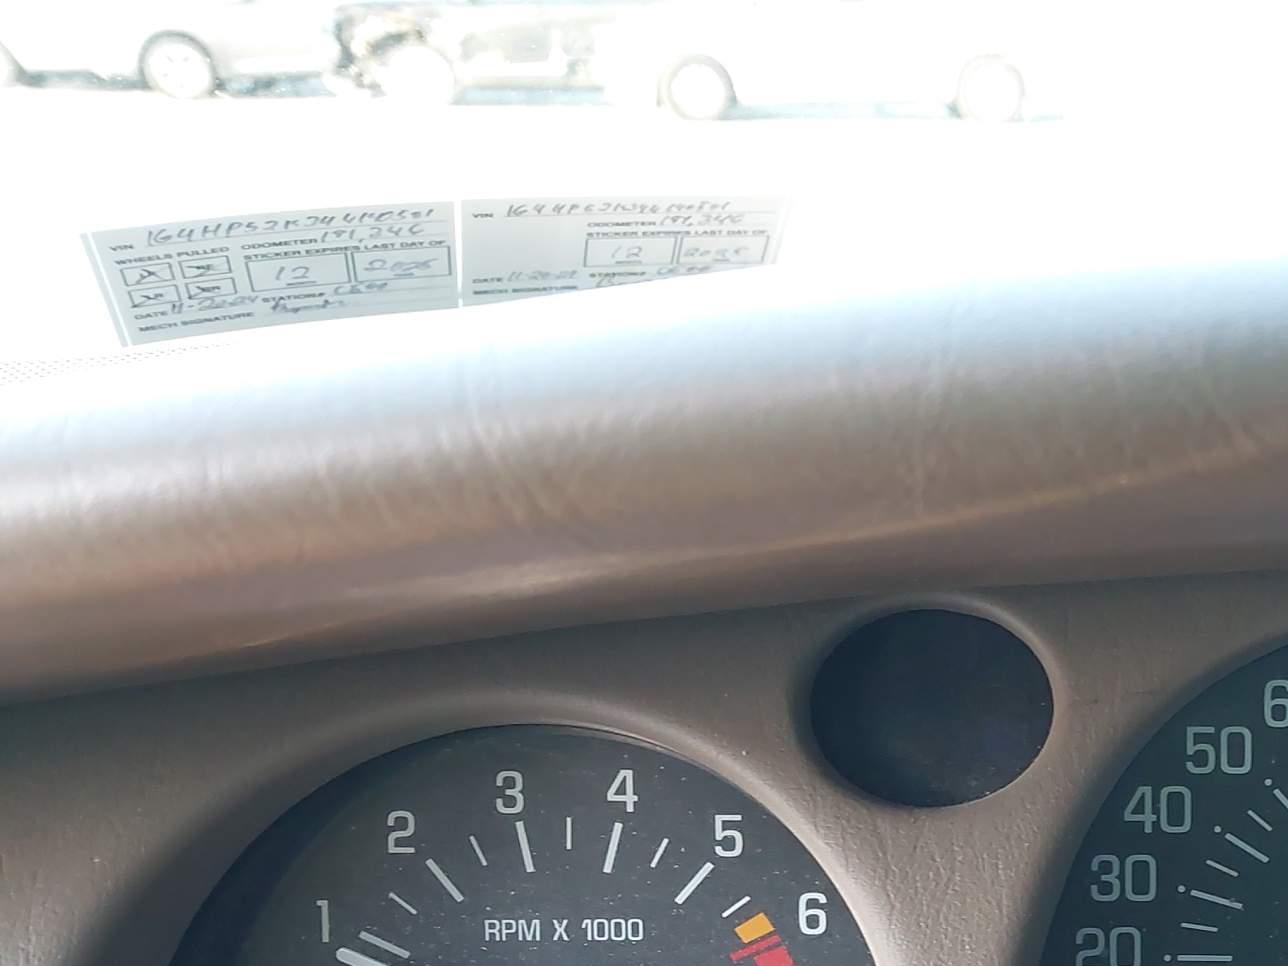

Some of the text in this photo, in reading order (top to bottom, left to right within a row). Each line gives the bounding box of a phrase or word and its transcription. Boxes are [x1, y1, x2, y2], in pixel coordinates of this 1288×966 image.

[586, 220, 657, 228] ODOMETER
[586, 230, 638, 238] STICKER
[726, 228, 748, 236] DAY
[109, 243, 134, 252] VIN
[241, 237, 318, 250] ODOMETER
[243, 238, 447, 260] STICKER EXPIRES LAST DAY OF
[114, 246, 230, 265] WHEELS PULLED
[275, 266, 310, 280] 12
[134, 310, 169, 320] DATE
[138, 312, 255, 333] MECH SIGNATURE
[1186, 727, 1251, 774] 50
[496, 771, 524, 813] 3
[607, 770, 638, 812] 4
[1124, 786, 1191, 833] 40
[388, 811, 415, 853] 2
[715, 815, 743, 857] 5
[1091, 855, 1156, 901] 30
[317, 900, 329, 942] 1
[799, 893, 827, 934] 6
[485, 919, 643, 941] RPM X 1000
